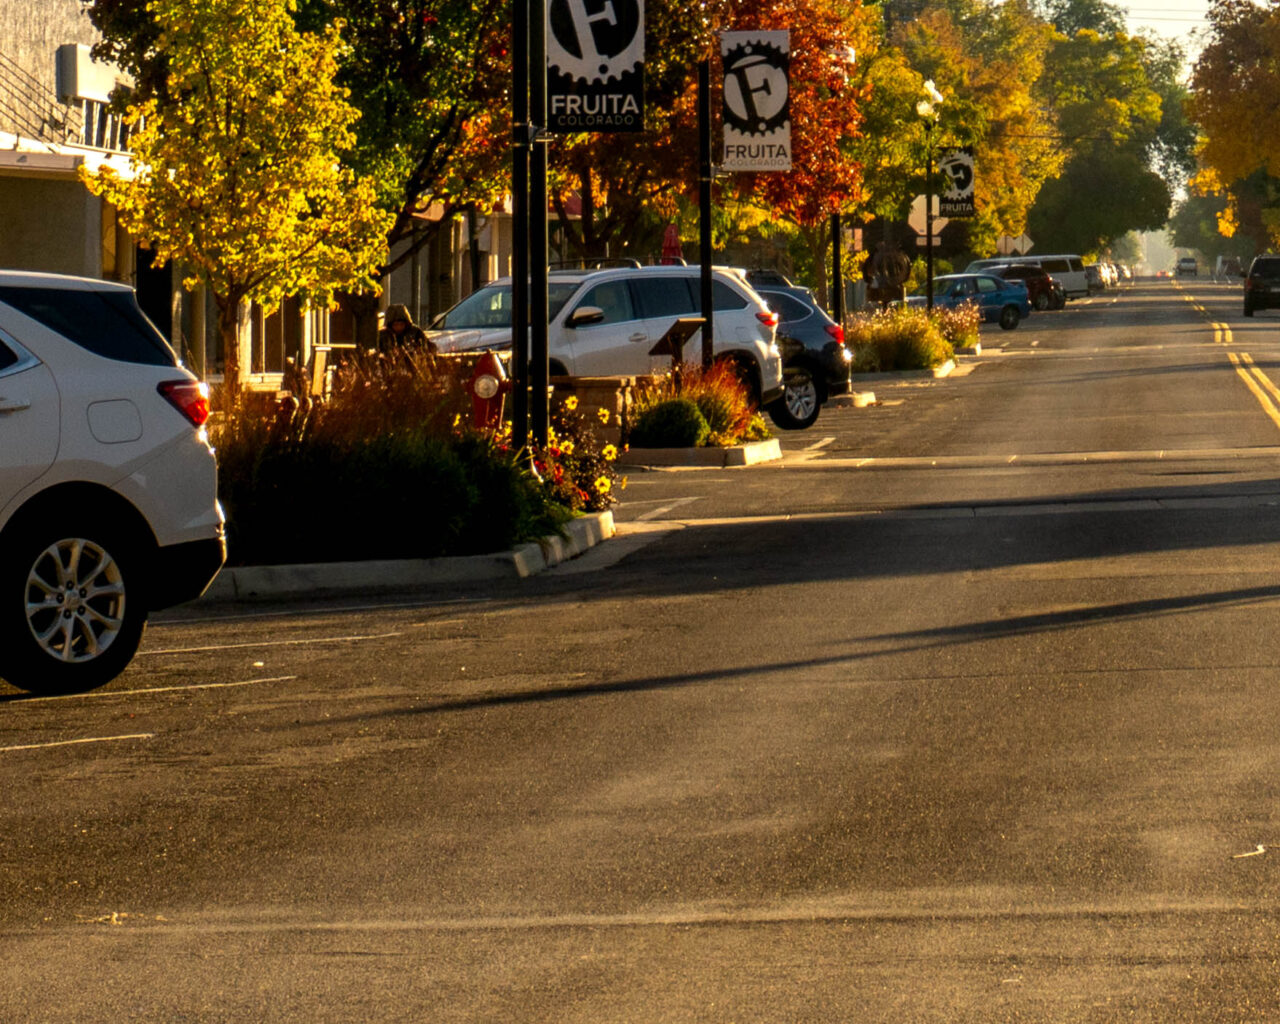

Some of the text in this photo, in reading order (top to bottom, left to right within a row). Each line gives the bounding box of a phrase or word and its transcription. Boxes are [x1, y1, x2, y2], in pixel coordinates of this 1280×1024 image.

[550, 93, 640, 114] FRUITA
[557, 114, 635, 126] COLORADO
[726, 144, 788, 159] FRUITA
[940, 202, 974, 212] FRUITA
